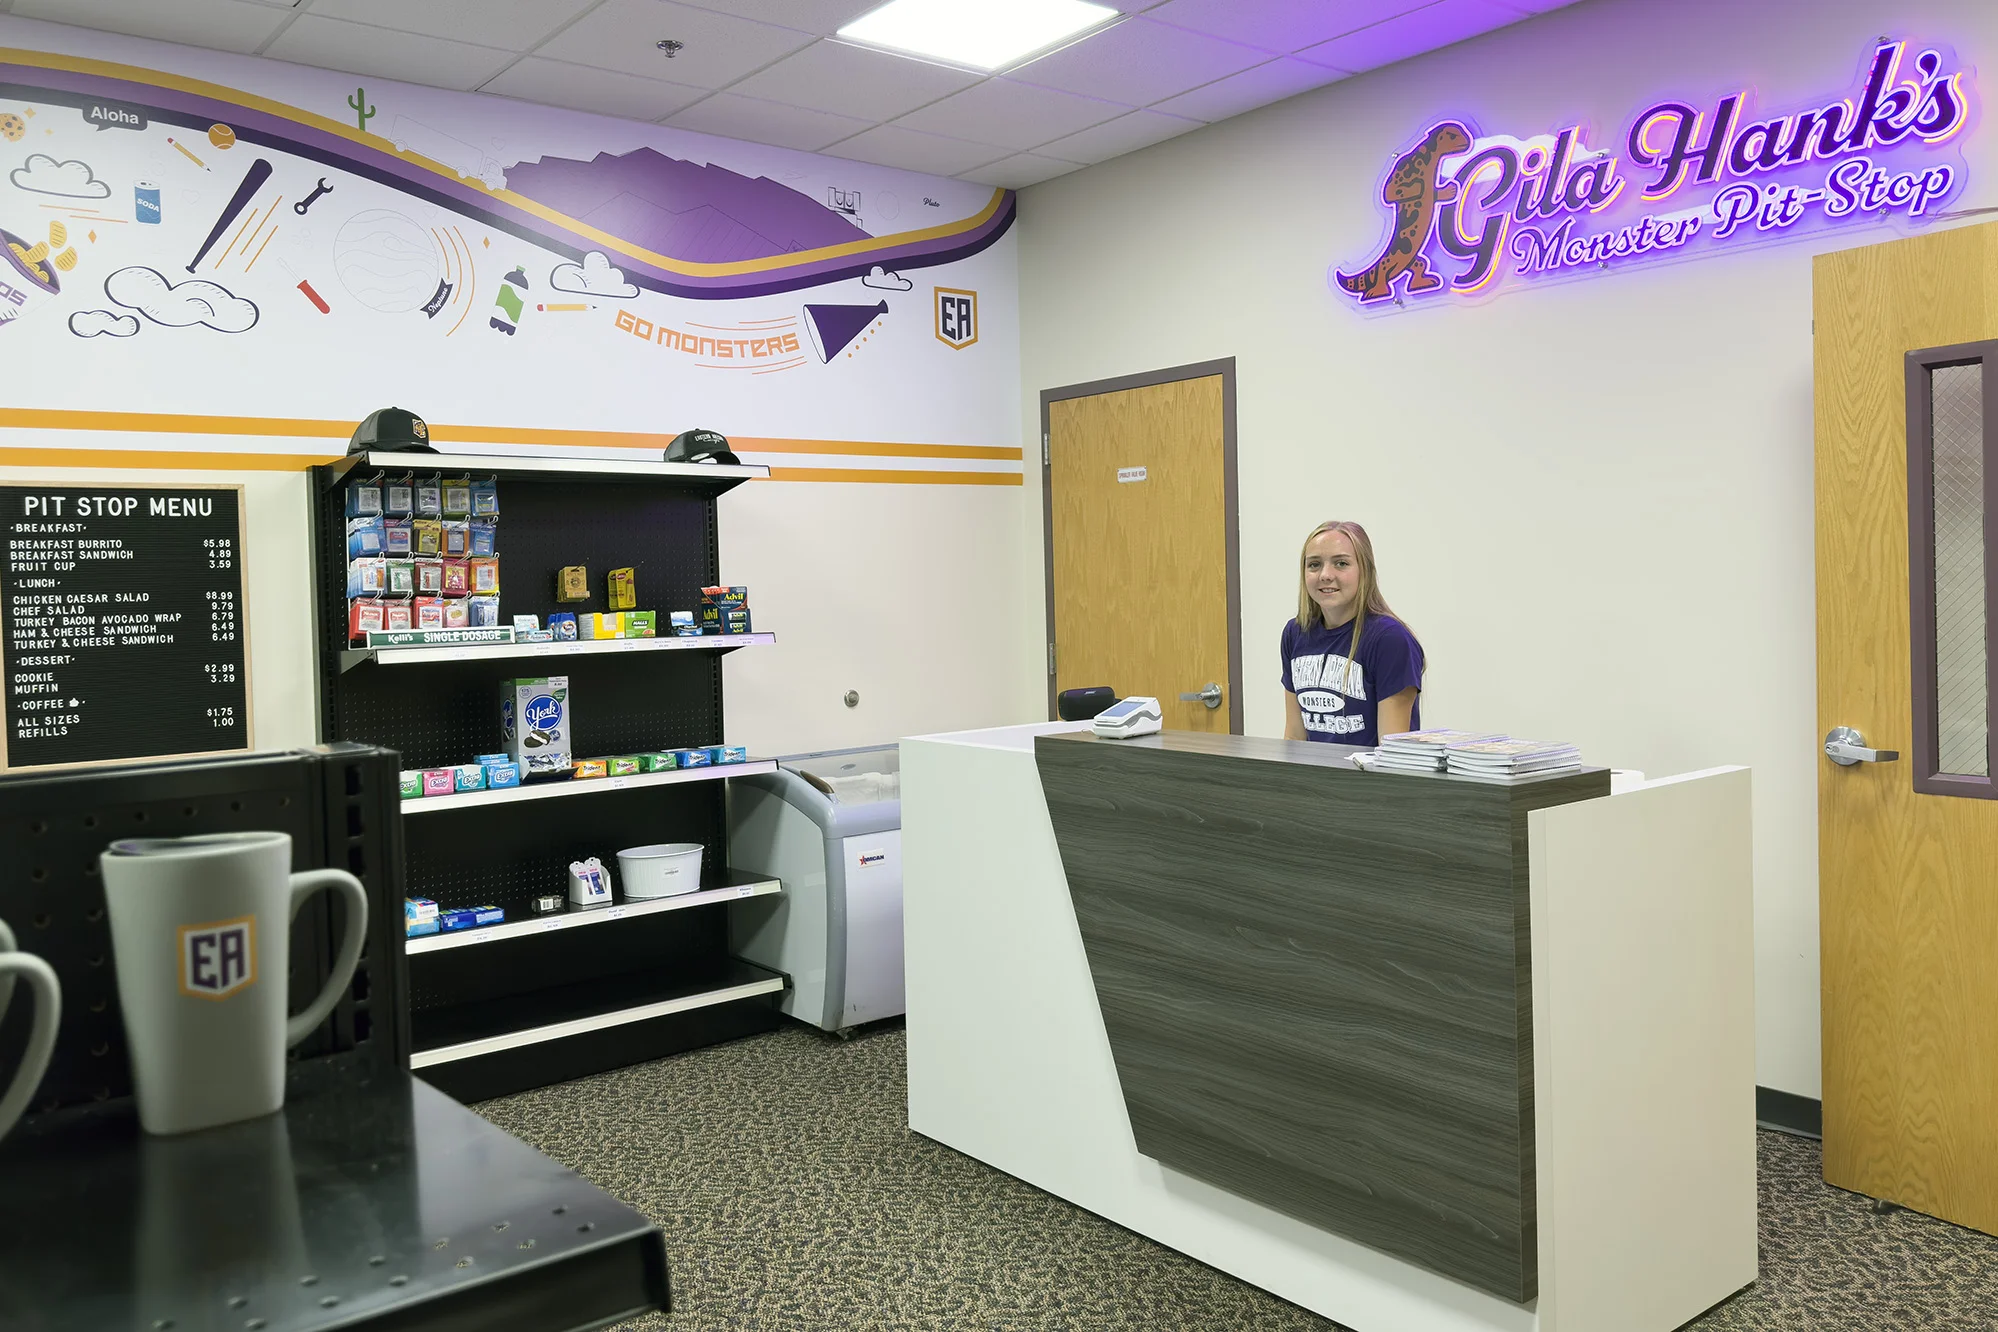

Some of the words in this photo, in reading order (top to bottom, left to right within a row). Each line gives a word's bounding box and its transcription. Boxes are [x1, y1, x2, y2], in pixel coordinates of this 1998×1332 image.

[91, 106, 139, 124] Aloha
[1436, 125, 1626, 293] Gila
[1626, 41, 1968, 201] Hank's
[136, 198, 160, 212] SODA
[1509, 213, 1703, 275] Monster
[1711, 155, 1955, 240] Pit-Stop
[428, 287, 449, 312] Neptune
[941, 296, 972, 341] EA
[614, 309, 654, 341] GO
[656, 326, 800, 358] MONSTERS
[25, 497, 66, 516] PIT
[77, 497, 137, 516] STOP
[150, 498, 211, 516] MENU
[10, 540, 74, 549] BREAKFAST
[79, 540, 122, 548] BURRITO
[204, 539, 230, 547] $5.98
[11, 551, 74, 560] BREAKFAST
[79, 550, 133, 559] SANDWICH
[12, 562, 47, 571] FRUIT
[54, 562, 75, 571] CUP
[210, 560, 231, 568] 3.59
[13, 595, 61, 604] CHICKEN
[67, 594, 108, 603] CAESAR
[115, 593, 149, 602] SALAD
[206, 592, 232, 600] $8.99
[13, 607, 40, 616] CHEF
[47, 606, 84, 615] SALAD
[212, 602, 233, 610] 9.79
[703, 608, 718, 620] Advil
[14, 618, 54, 627] TURKEY
[63, 616, 95, 625] BACON
[102, 614, 148, 624] AVOCADO
[155, 613, 181, 622] WRAP
[212, 612, 233, 620] 6.79
[14, 629, 35, 638] HAM
[41, 628, 49, 637] &
[53, 627, 95, 637] CHEESE
[104, 625, 156, 635] SANDWICH
[212, 622, 234, 631] 6.49
[388, 633, 413, 644] Kelli's
[424, 631, 460, 643] SINGLE
[462, 630, 501, 642] DOSAGE
[14, 640, 56, 649] TURKEY
[62, 638, 70, 647] &
[73, 637, 115, 647] CHEESE
[122, 635, 173, 644] SANDWICH
[213, 632, 234, 641] 6.49
[205, 664, 234, 672] $2.99
[15, 673, 53, 683] COOKIE
[211, 674, 234, 683] 3.29
[15, 684, 58, 694] MUFFIN
[1302, 697, 1335, 708] MONSTERS
[207, 709, 232, 718] $1.75
[526, 699, 559, 731] York
[18, 718, 40, 728] ALL
[45, 715, 79, 727] SIZES
[214, 718, 233, 727] 1.00
[18, 727, 67, 738] REFILLS
[190, 928, 246, 990] EA
